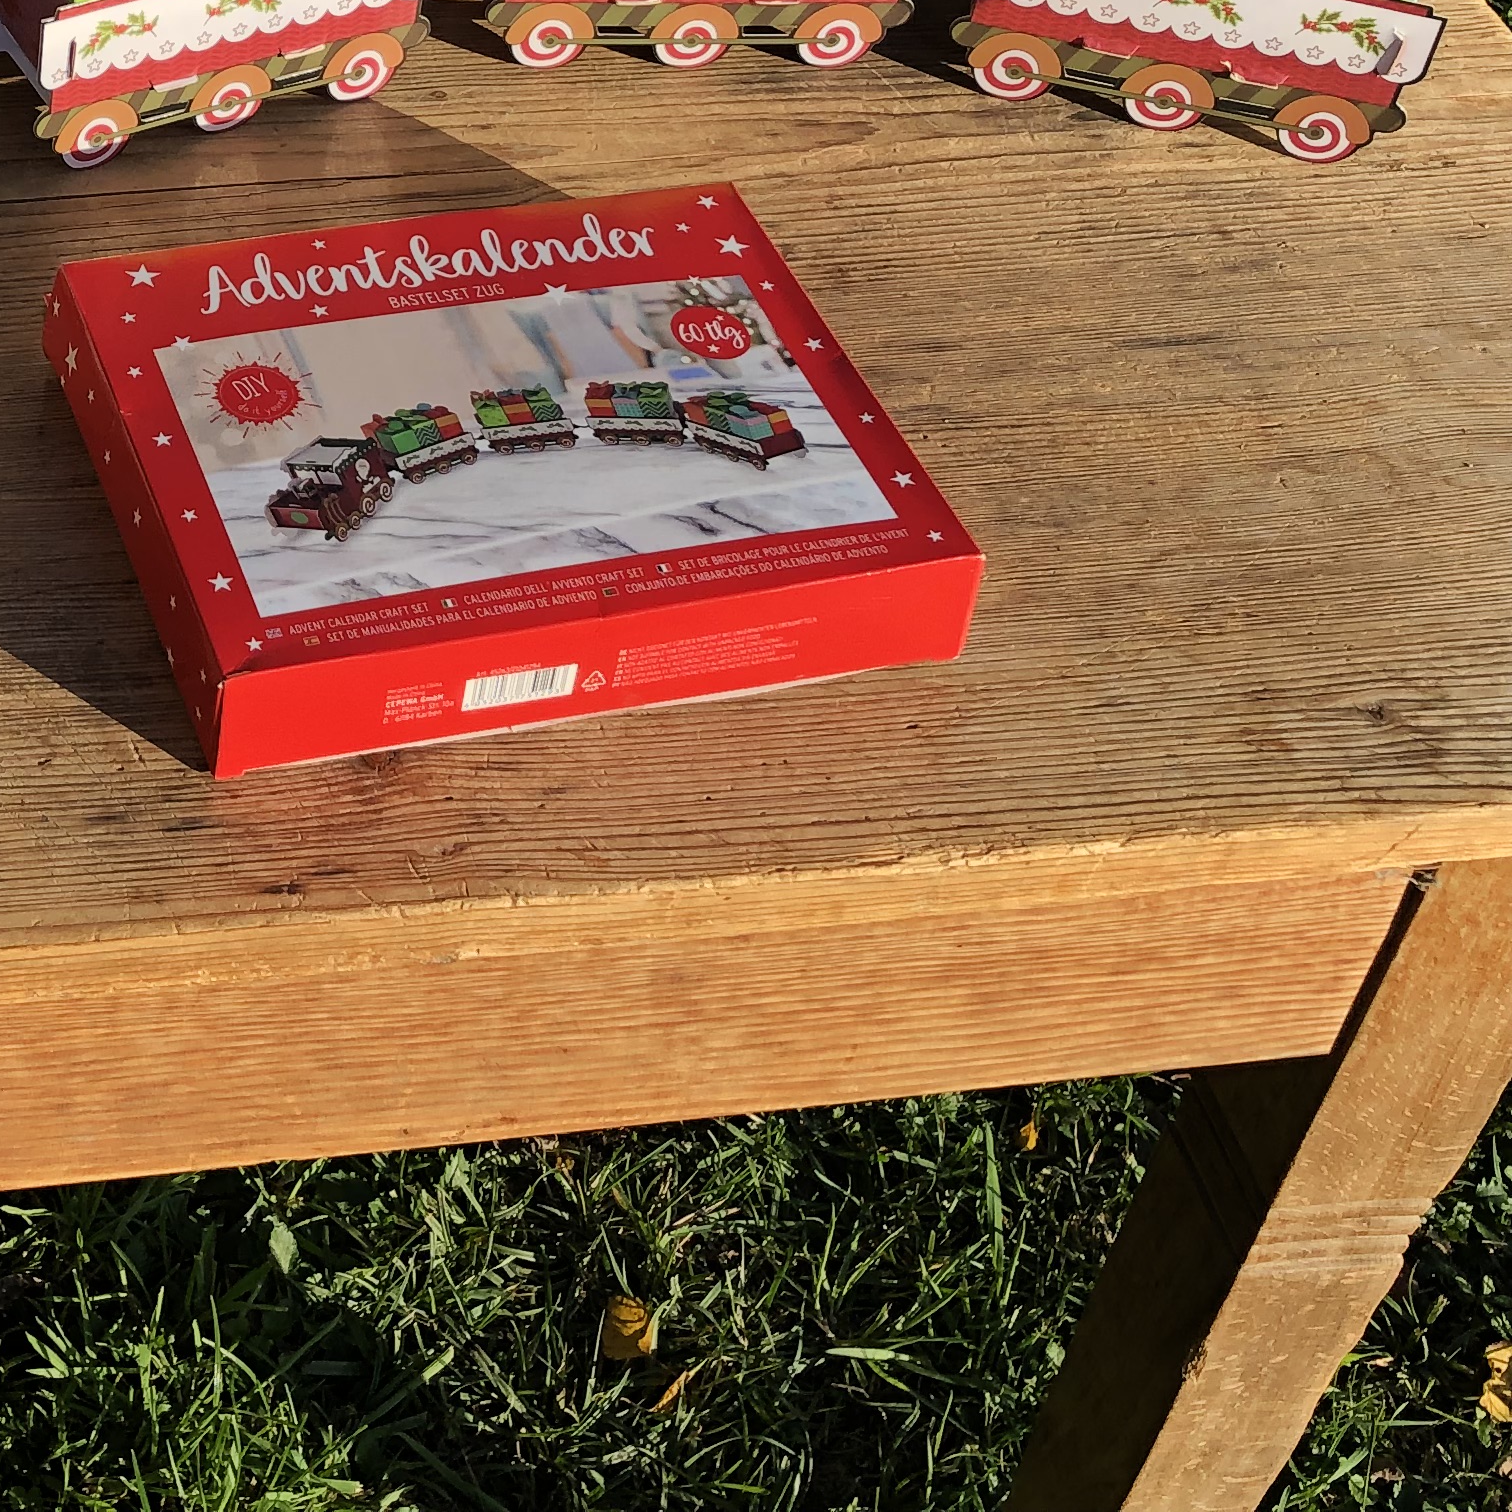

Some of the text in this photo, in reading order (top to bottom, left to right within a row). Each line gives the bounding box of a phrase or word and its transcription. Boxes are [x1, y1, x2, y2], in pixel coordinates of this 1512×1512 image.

[200, 213, 654, 315] Adventskalender
[388, 283, 505, 309] BASTELSET ZUG
[678, 323, 705, 343] 60
[232, 372, 270, 401] DIY
[625, 544, 888, 594] CONJUNTO DE EMBARCAÇÕES DO CALENDÁRIO DE ADVENTO
[678, 560, 696, 571] SET
[698, 557, 711, 568] DE
[712, 548, 762, 566] BRICOLAGE
[762, 545, 789, 558] POUR
[790, 543, 803, 554] LE
[803, 535, 858, 552] CALENDRIER
[859, 533, 872, 544] DE
[463, 586, 522, 605] CALENDARIO
[595, 570, 626, 585] CRAFT
[627, 567, 645, 579] SET
[289, 602, 429, 635] ADVENT CALENDAR CRAFT SET
[327, 590, 597, 643] SET DE MANUALIDADES PARA EL CALENDARIO DE ADVIENTO
